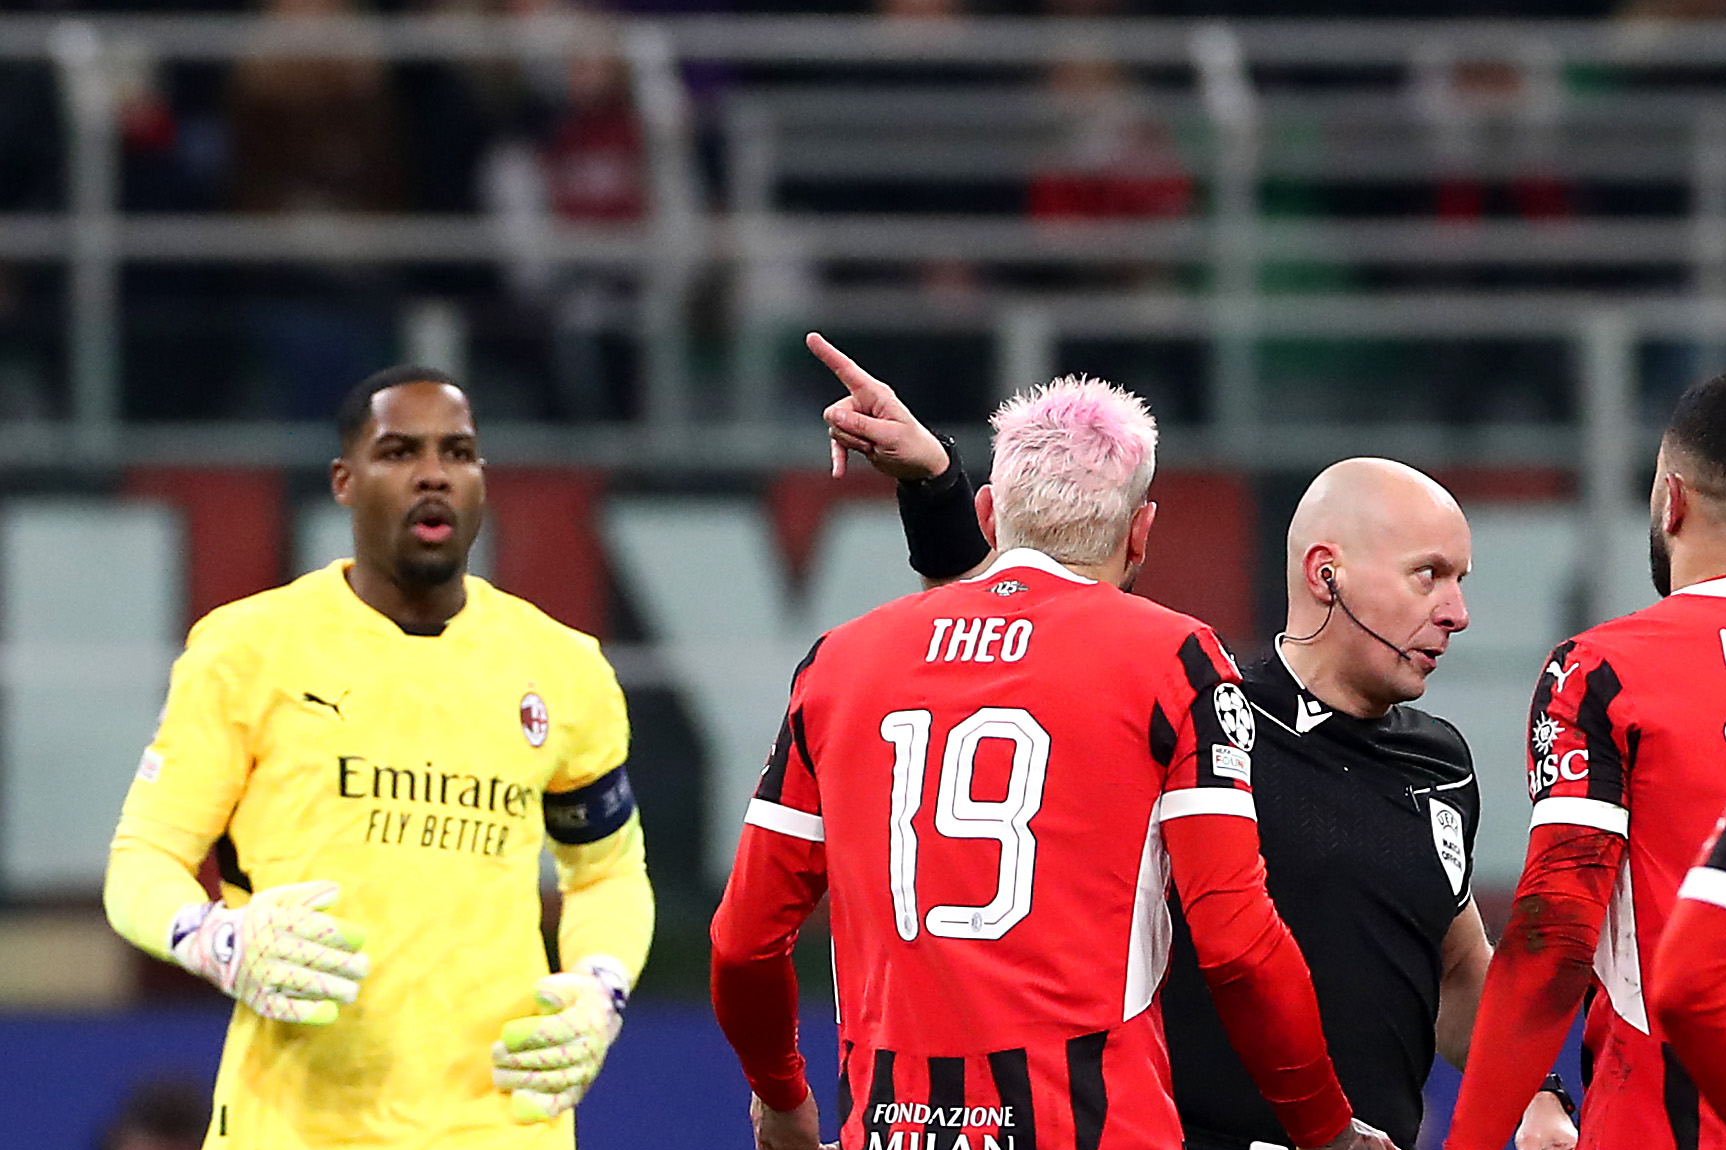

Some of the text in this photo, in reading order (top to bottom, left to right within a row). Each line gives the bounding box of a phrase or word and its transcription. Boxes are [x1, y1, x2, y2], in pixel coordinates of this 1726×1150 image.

[925, 617, 1034, 662] THEO
[1528, 749, 1589, 798] MSC
[366, 809, 411, 844] FLY
[421, 815, 509, 857] BETTER
[880, 707, 1051, 941] 19
[872, 1102, 1015, 1127] FONDAZIONE
